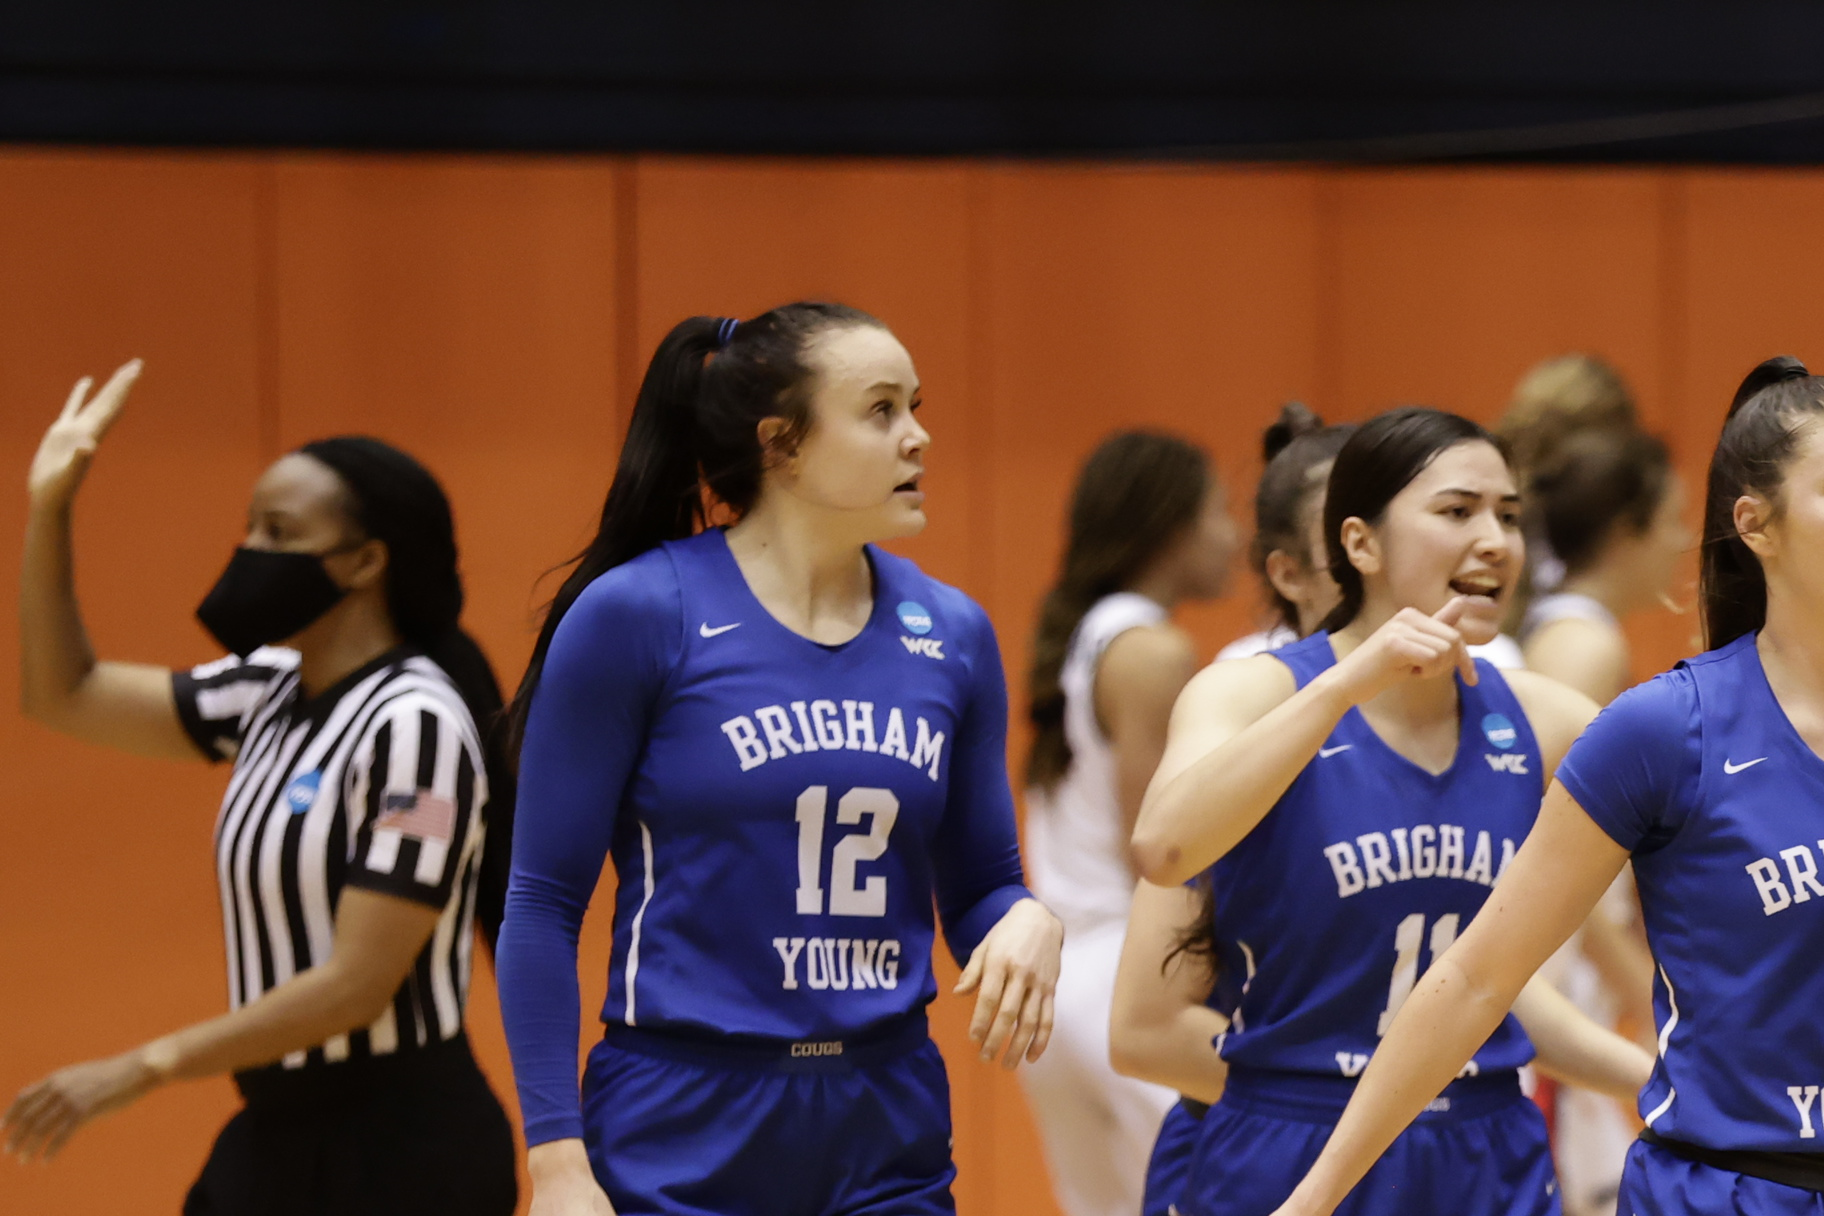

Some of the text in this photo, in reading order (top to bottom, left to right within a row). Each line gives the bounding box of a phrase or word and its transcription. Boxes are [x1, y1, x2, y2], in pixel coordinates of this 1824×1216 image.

[720, 699, 946, 782] BRIGHAM
[795, 785, 899, 917] 12
[772, 937, 901, 991] YOUNG
